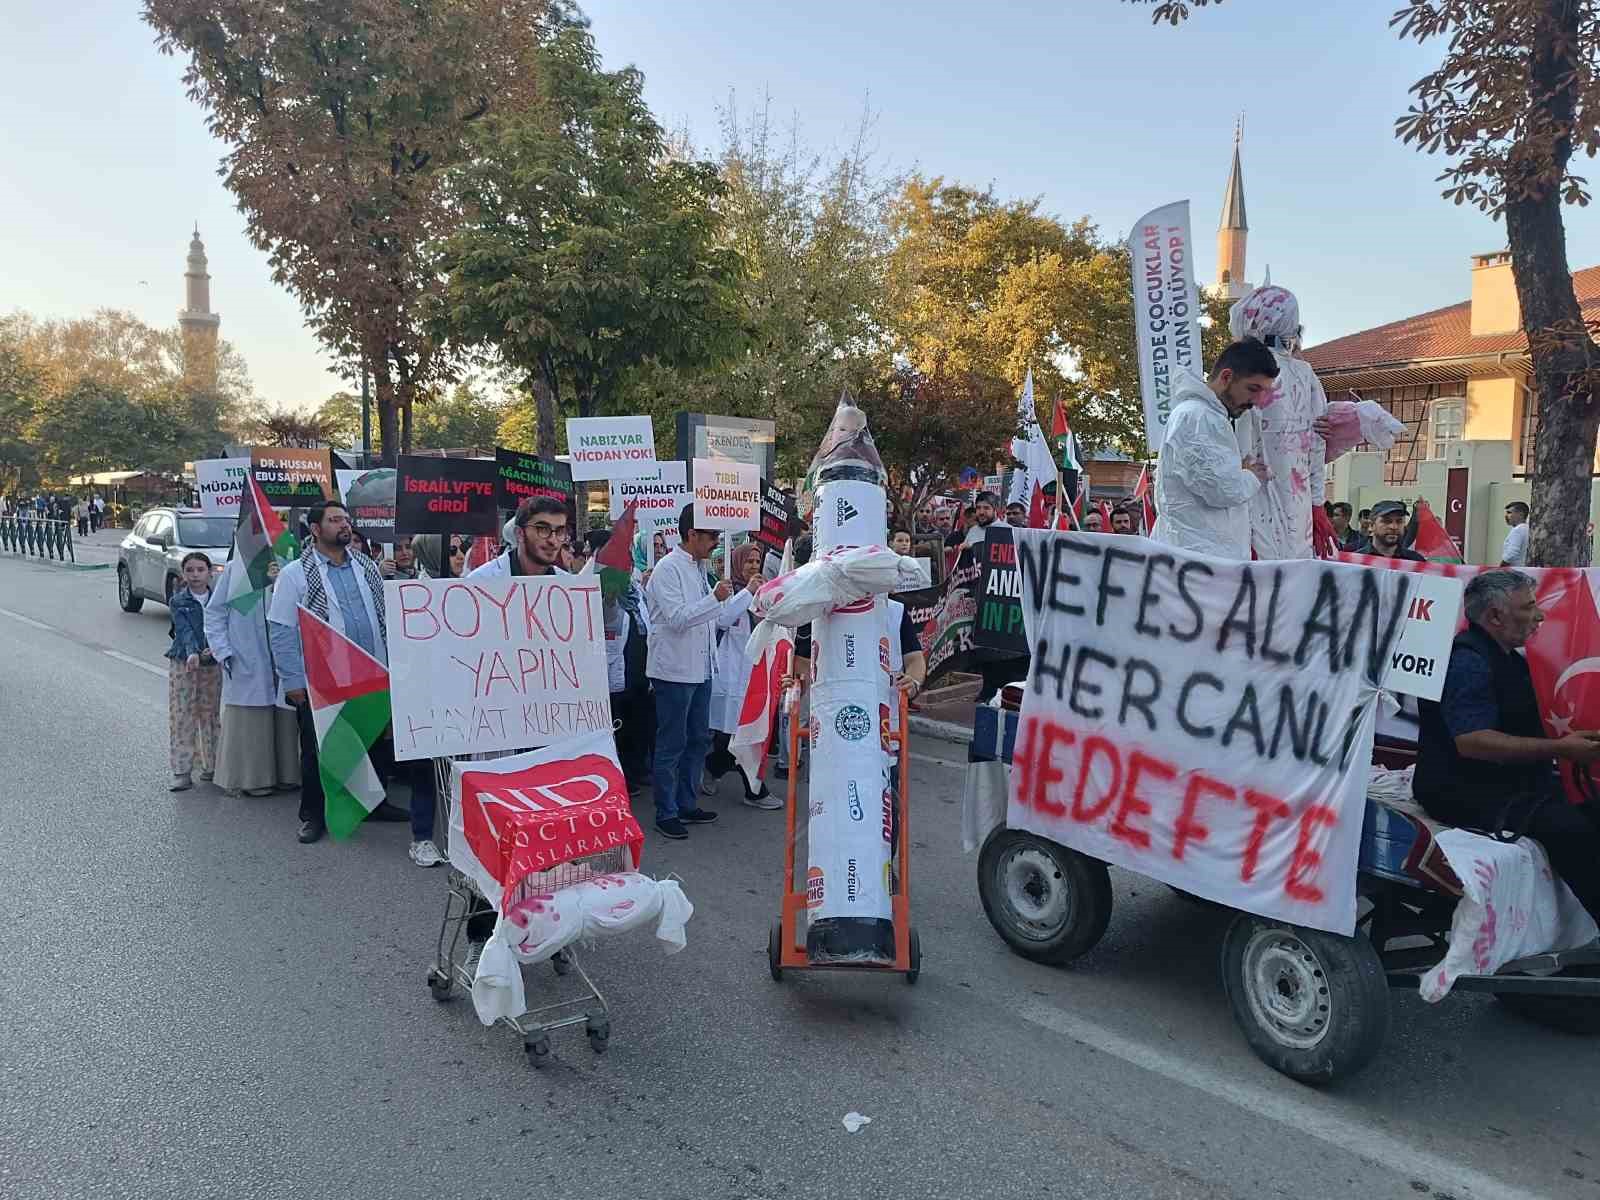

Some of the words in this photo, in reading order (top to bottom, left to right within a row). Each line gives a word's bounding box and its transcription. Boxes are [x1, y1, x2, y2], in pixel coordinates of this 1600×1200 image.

[1143, 223, 1171, 333] ÇOCUKLAR
[1150, 334, 1171, 426] GAZZE'DE
[574, 449, 621, 462] VİCDAN
[624, 447, 653, 459] YOK!
[580, 434, 618, 447] NABIZ
[620, 434, 643, 444] VAR
[255, 471, 277, 481] EBU
[260, 459, 278, 468] DR.
[280, 460, 322, 470] HUSSAM
[404, 475, 450, 494] İSRAİL
[695, 485, 759, 503] MÜDAHALEYE
[427, 496, 469, 512] GİRDİ
[705, 503, 750, 518] KORİDOR
[837, 498, 845, 527] adidas
[400, 582, 600, 643] BOYKOT
[981, 601, 1003, 632] IN
[1019, 539, 1213, 643] NEFES
[1215, 566, 1408, 684] ALAN
[450, 647, 579, 698] YAPIN
[523, 697, 610, 737] KURTARIN
[1033, 638, 1163, 732] HER
[1176, 670, 1366, 774] CANLI
[847, 858, 856, 903] amazon
